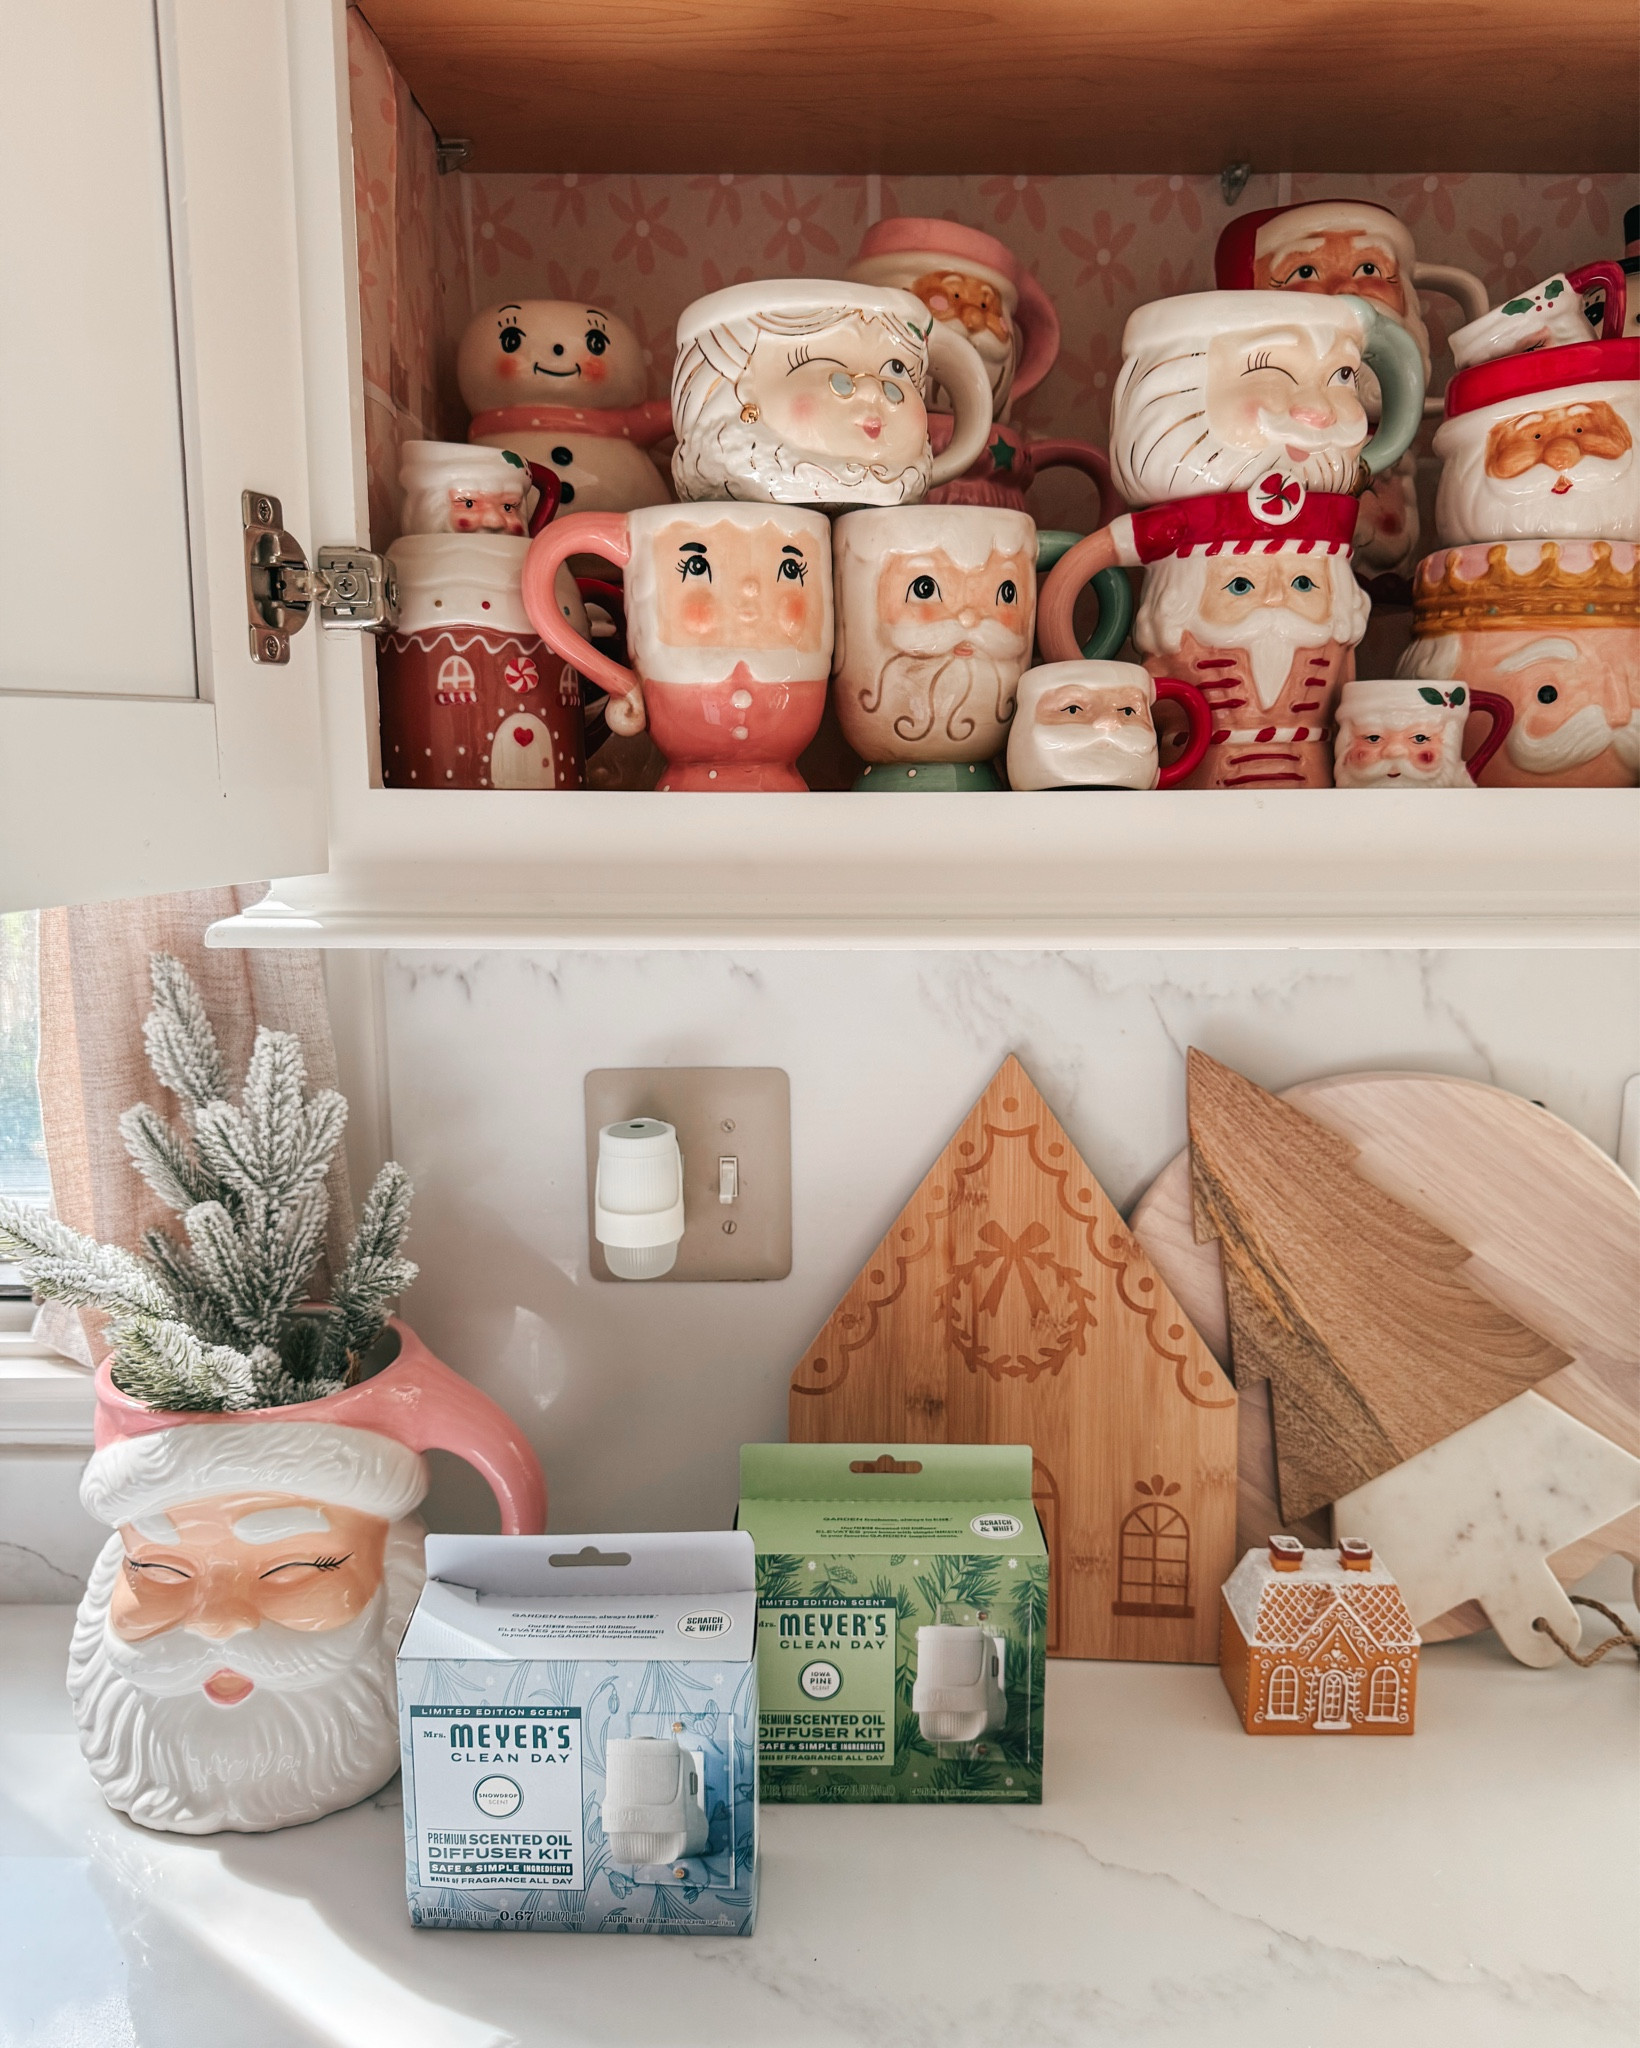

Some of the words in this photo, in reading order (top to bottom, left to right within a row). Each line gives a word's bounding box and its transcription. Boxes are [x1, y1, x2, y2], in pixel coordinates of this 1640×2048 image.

[687, 1616, 723, 1624] SCRATCH
[780, 1613, 887, 1636] MEYER'S
[780, 1640, 841, 1649] CLEAN
[851, 1640, 886, 1649] DAY
[421, 1708, 471, 1716] LIMITED
[476, 1708, 525, 1716] EDITION
[793, 1714, 859, 1725] SCENTED
[862, 1714, 886, 1725] OIL
[450, 1723, 571, 1749] MEYER'S
[759, 1727, 849, 1738] DIFFUSER
[854, 1728, 886, 1738] KIT
[451, 1752, 519, 1763] CLEAN
[531, 1753, 570, 1763] DAY
[427, 1832, 467, 1845] PREMIUM
[469, 1834, 543, 1846] SCENTED
[546, 1835, 573, 1846] OIL
[428, 1847, 532, 1860] DIFFUSER
[539, 1849, 573, 1860] KIT
[431, 1864, 461, 1873] SAFE
[464, 1865, 473, 1873] &
[476, 1864, 520, 1873] SIMPLE
[523, 1865, 571, 1874] INGREDIENTS
[461, 1876, 527, 1884] FRAGRANCE
[499, 1910, 534, 1921] 0.67
